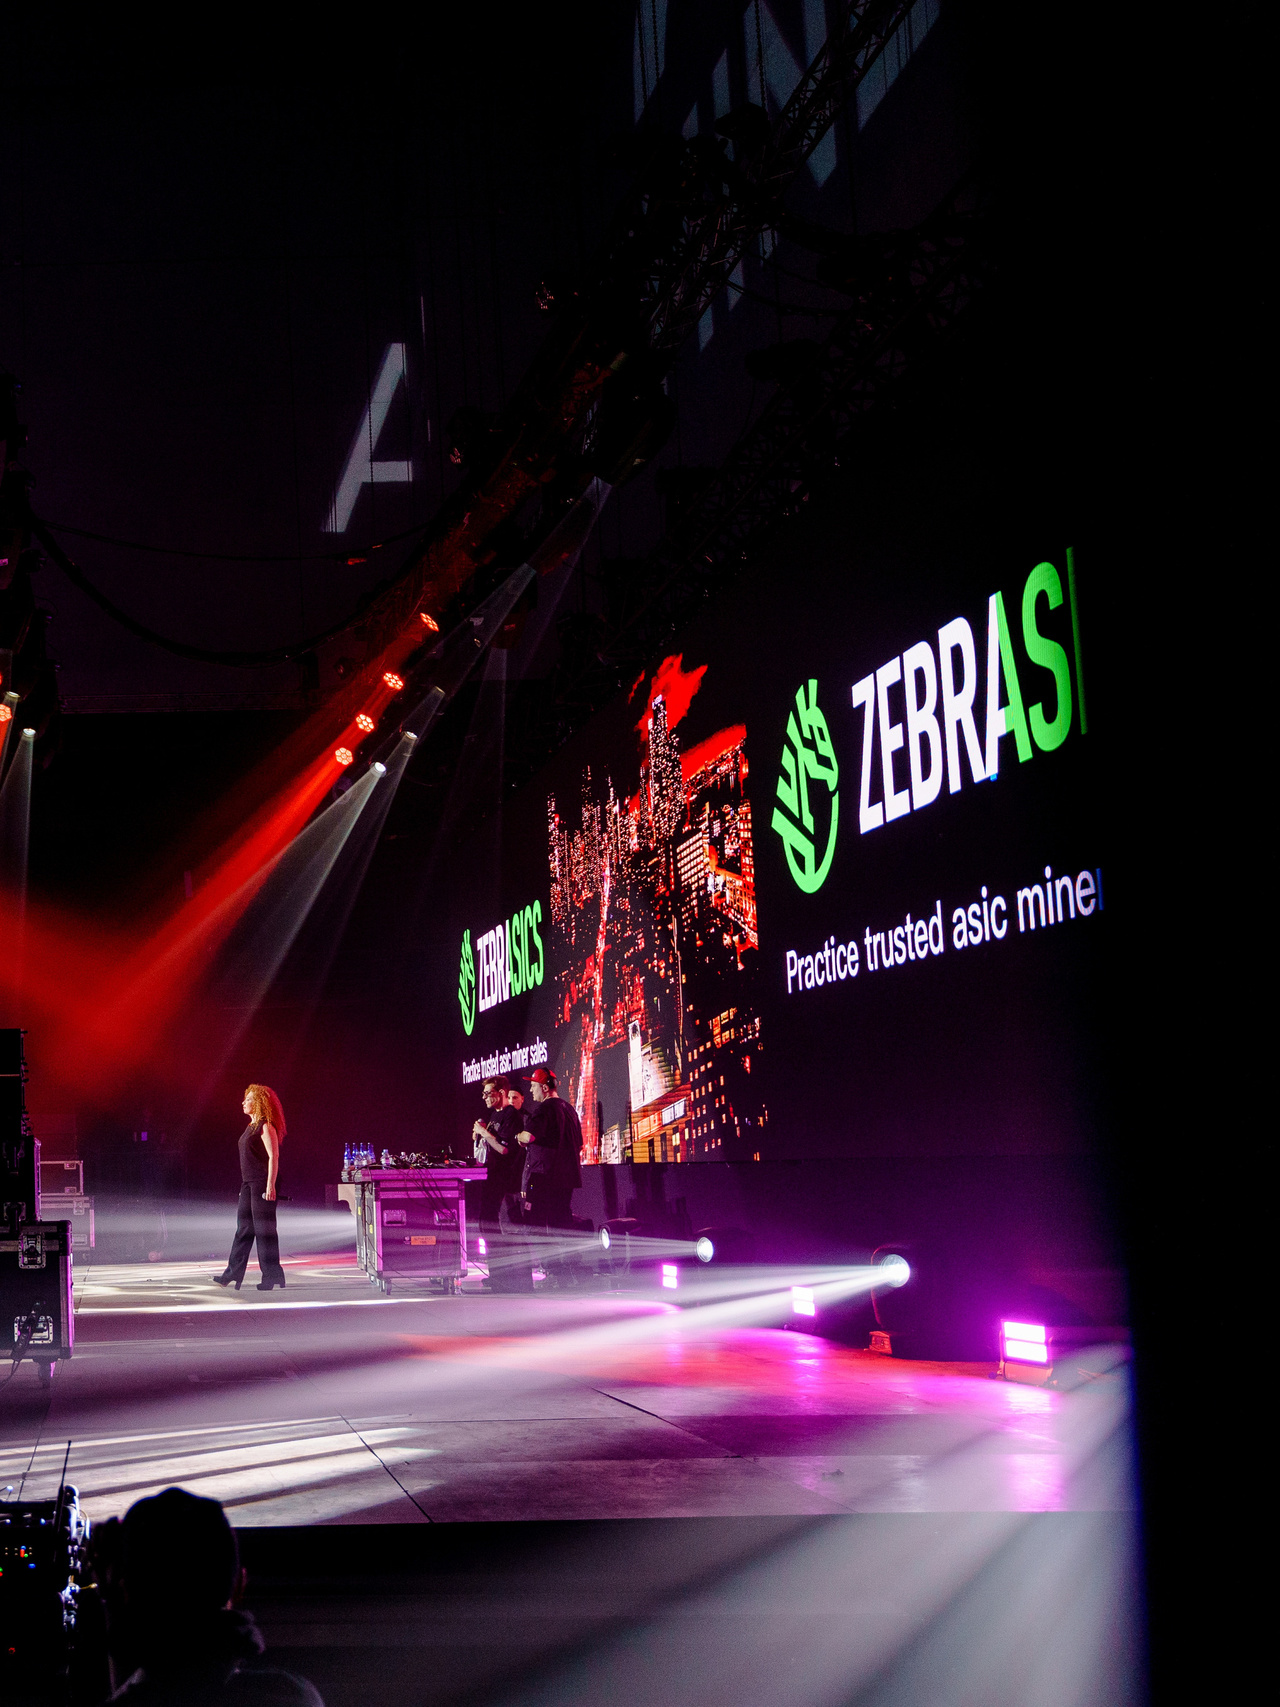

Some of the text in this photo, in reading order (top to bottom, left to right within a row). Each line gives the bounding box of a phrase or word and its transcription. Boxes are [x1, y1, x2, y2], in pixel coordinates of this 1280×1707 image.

[477, 899, 545, 1013] ZEBRASICS
[786, 935, 859, 994] Practice
[864, 900, 944, 971] trusted
[952, 885, 1008, 950] asic
[462, 1036, 548, 1085] Practice trusted asic miner sales
